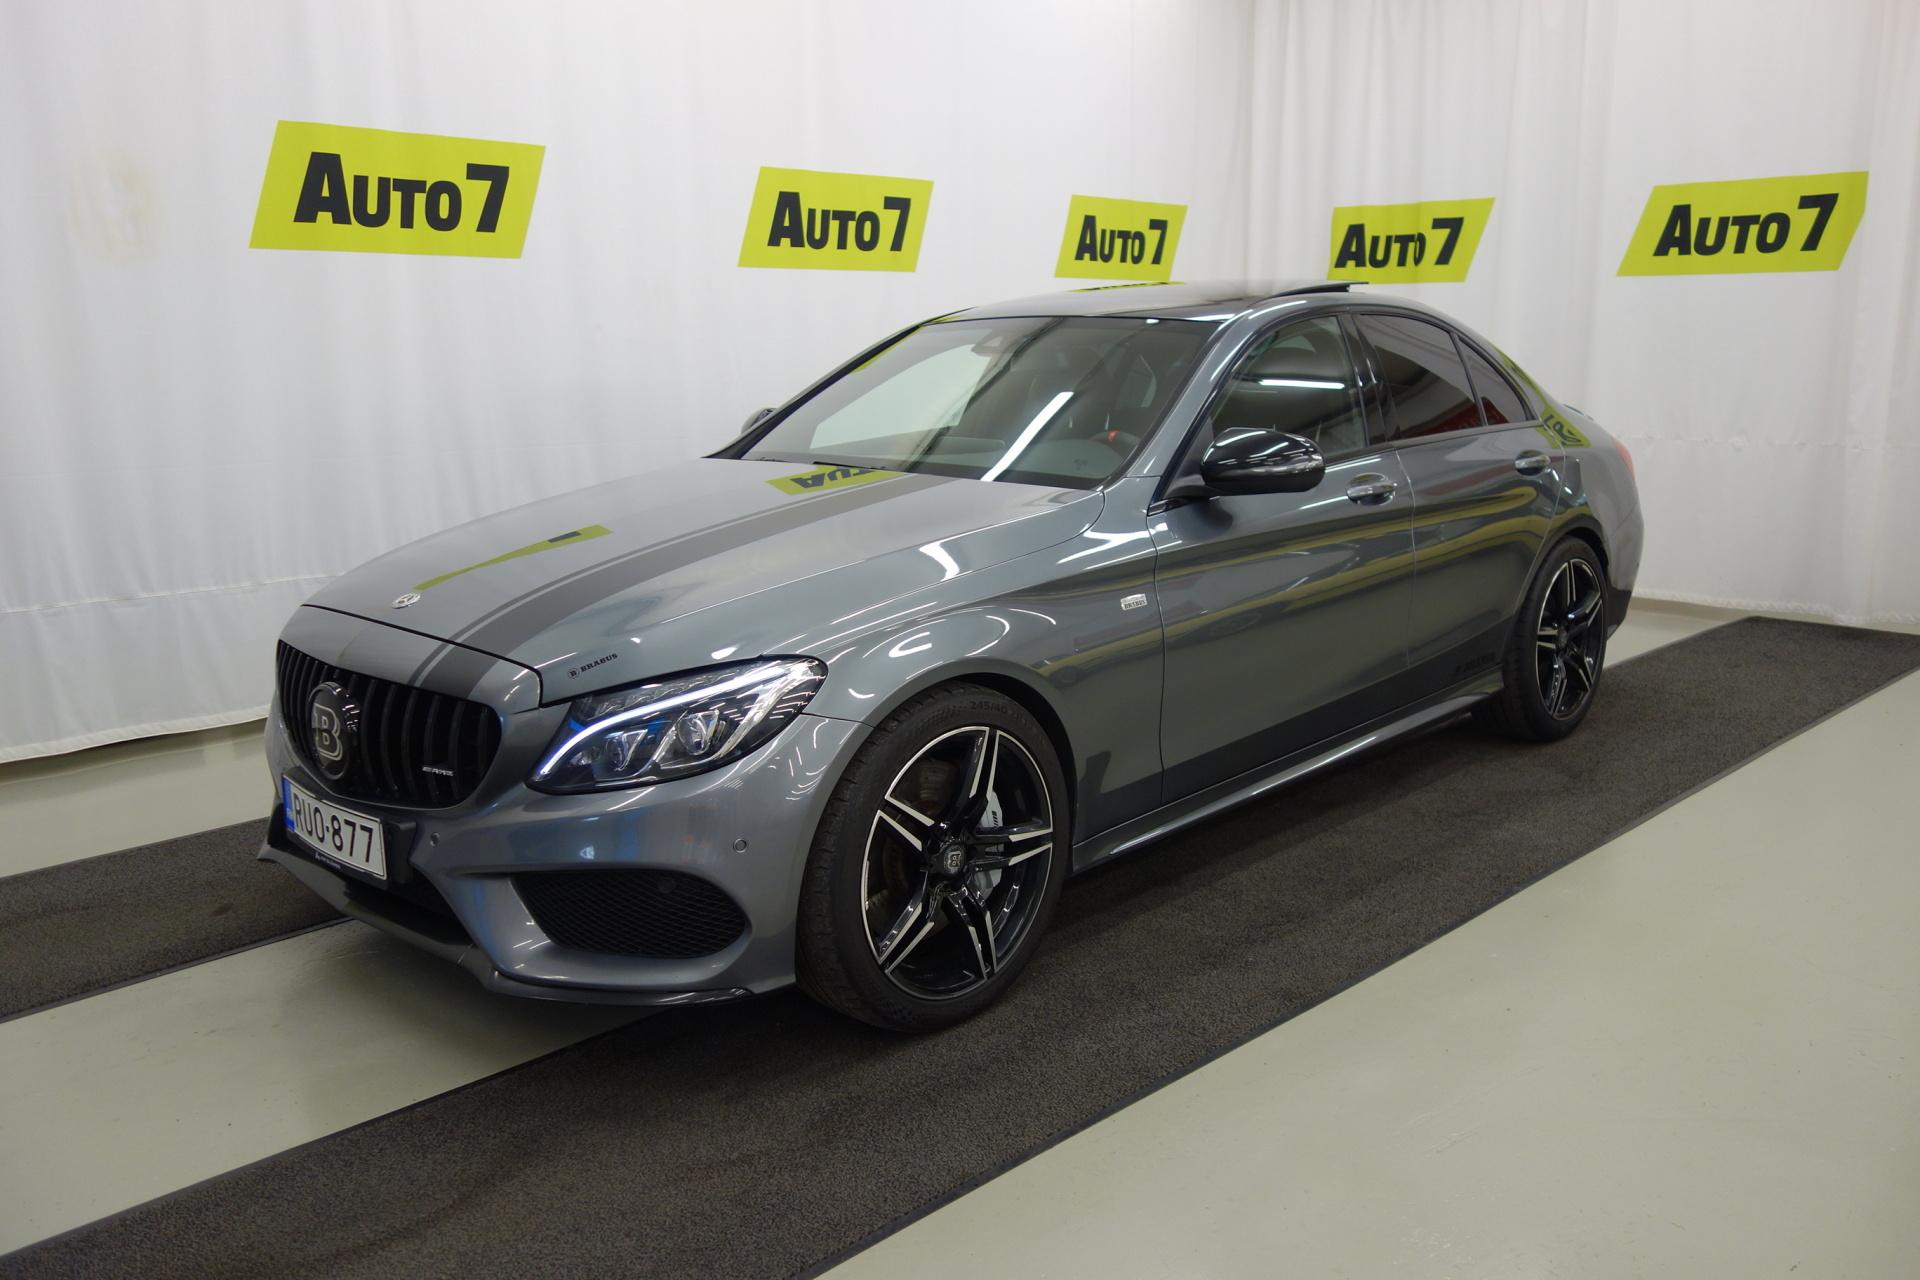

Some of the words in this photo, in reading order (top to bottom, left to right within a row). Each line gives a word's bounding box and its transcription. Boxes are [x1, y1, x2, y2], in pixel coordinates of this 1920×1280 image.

[580, 653, 618, 673] BRABUS
[314, 703, 343, 761] B
[293, 792, 374, 864] RUO-877
